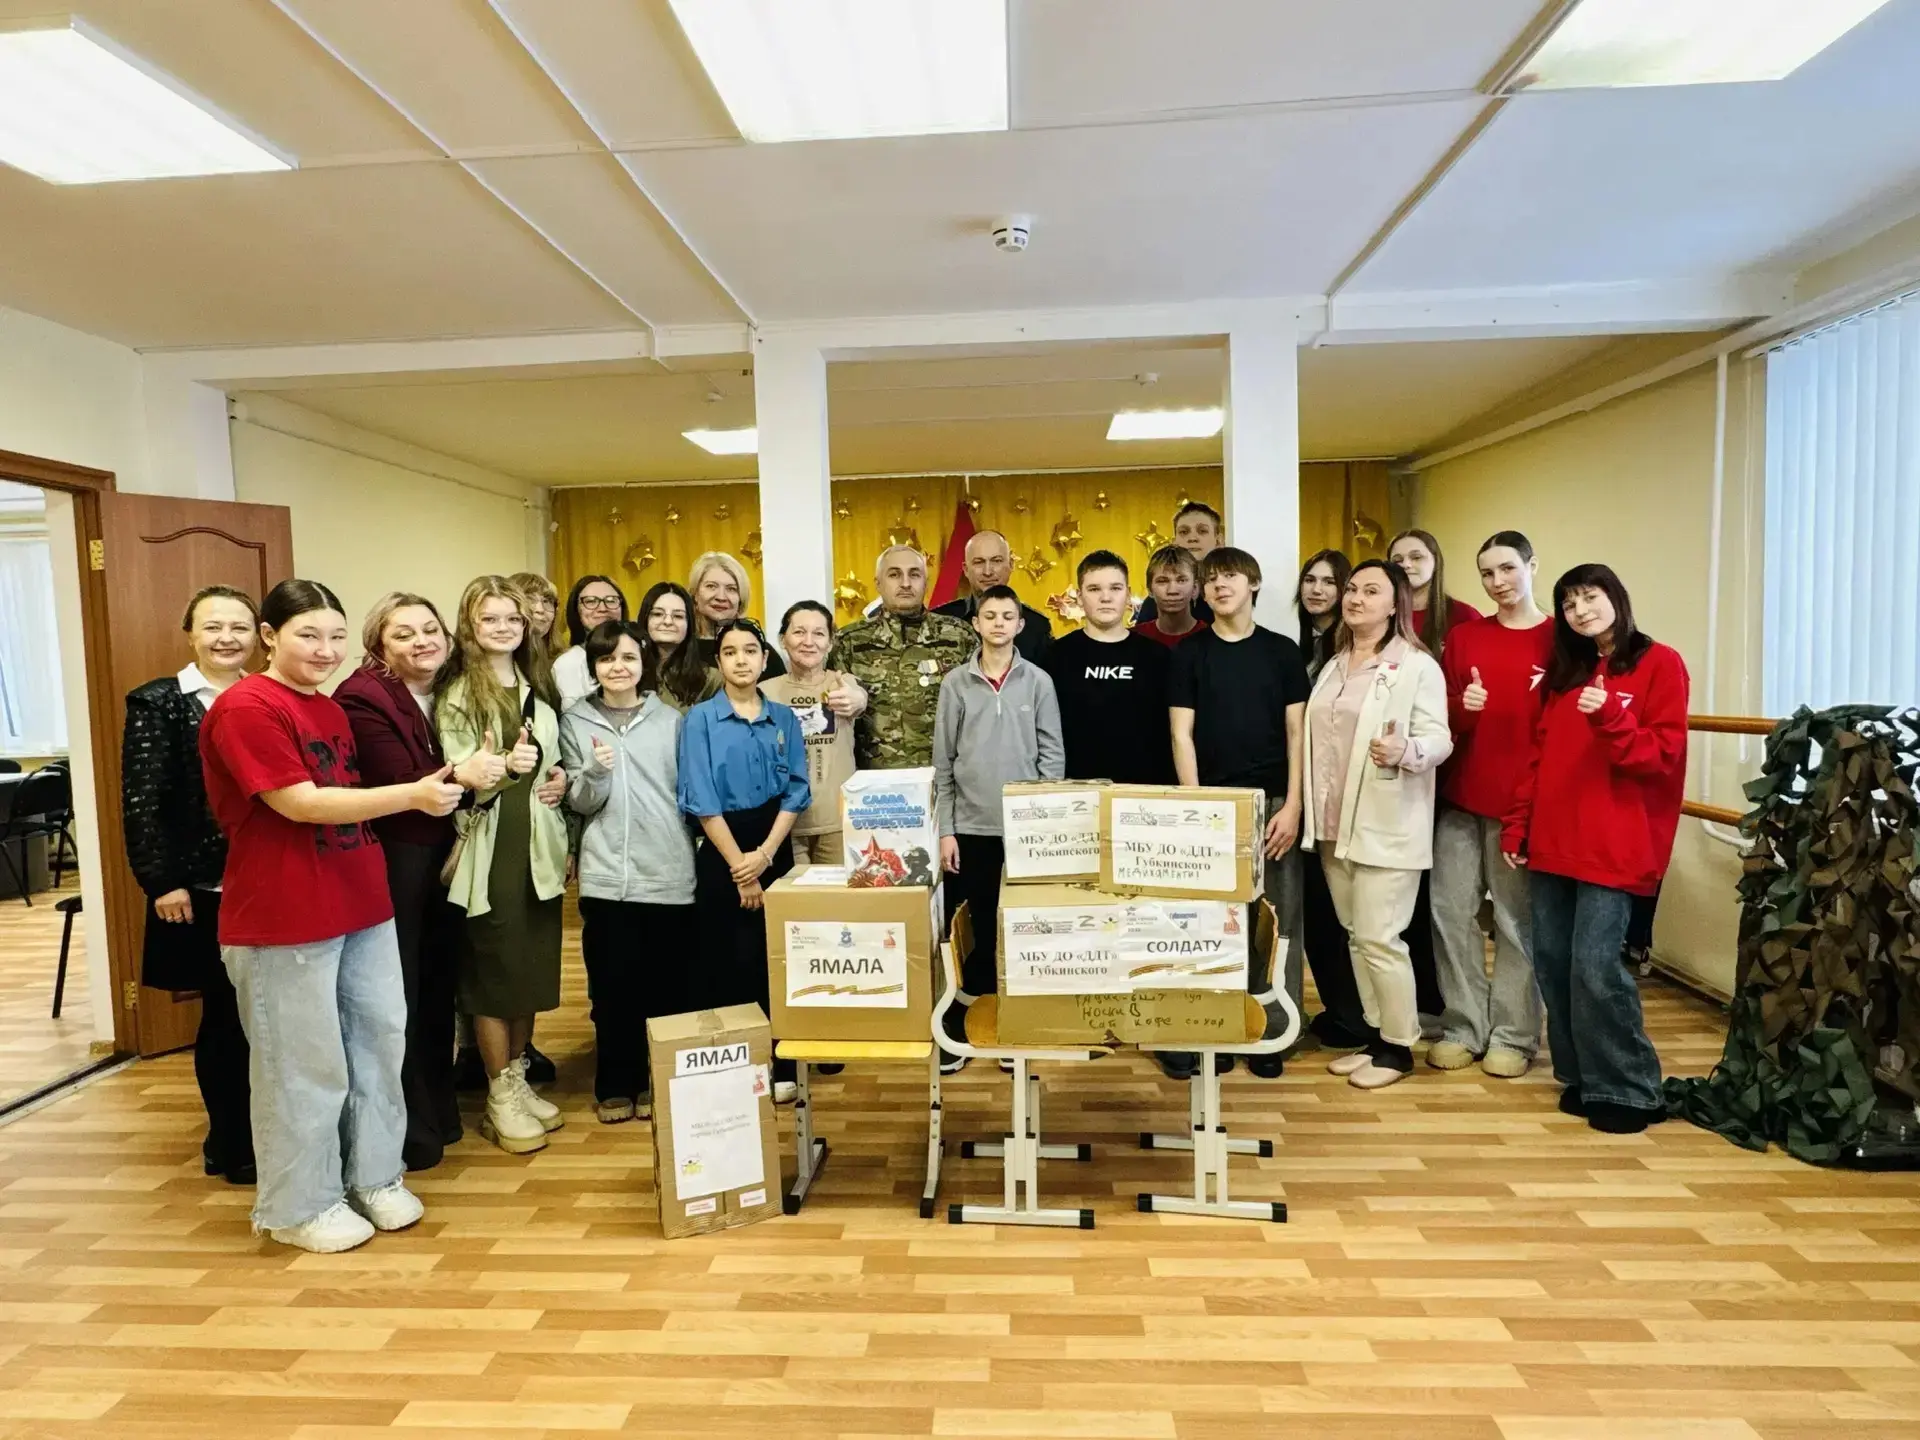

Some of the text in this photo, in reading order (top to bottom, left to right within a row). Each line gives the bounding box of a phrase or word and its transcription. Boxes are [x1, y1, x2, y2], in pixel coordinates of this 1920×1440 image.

[1085, 666, 1134, 679] NIKE
[791, 696, 818, 704] COOL
[804, 737, 835, 746] TUATED
[1019, 835, 1047, 845] МБУ
[1049, 834, 1068, 846] ДО
[1125, 841, 1221, 859] МБУ ДО «ДДТ»
[1136, 856, 1211, 871] Губкинского
[1146, 939, 1222, 955] СОЛДАТУ
[1020, 950, 1118, 963] МБУ ДО «ДДТ»
[809, 958, 884, 974] ЯМАЛА
[1030, 965, 1108, 978] Губкинского
[686, 1045, 747, 1069] ЯМАЛ
